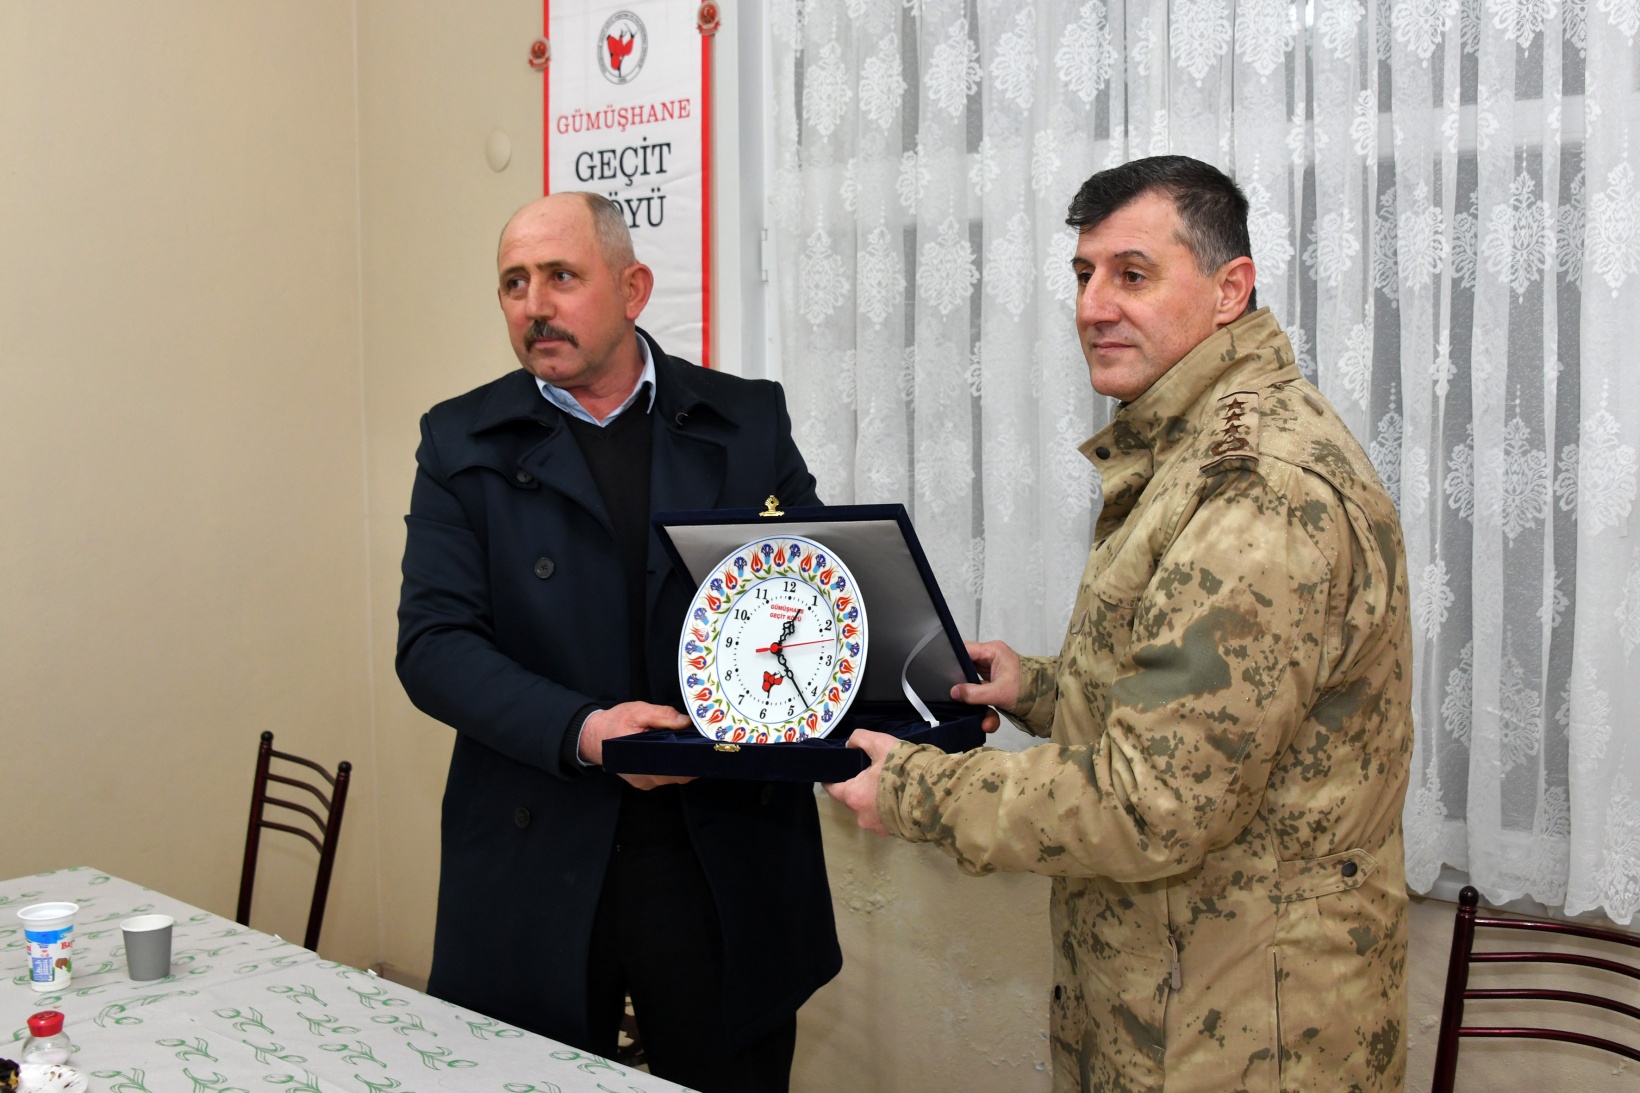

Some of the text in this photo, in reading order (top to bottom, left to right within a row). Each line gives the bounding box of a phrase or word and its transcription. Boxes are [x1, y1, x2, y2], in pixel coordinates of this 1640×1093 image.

[556, 98, 691, 135] GÜMÜŞHANE
[575, 136, 671, 187] GEÇİT
[783, 581, 797, 593] 12
[755, 588, 768, 600] 11
[811, 595, 818, 606] 1
[734, 609, 748, 620] 10
[824, 619, 832, 631] 2
[726, 636, 733, 648] 9
[825, 655, 833, 666] 3
[724, 670, 732, 681] 8
[811, 686, 818, 697] 4
[738, 694, 745, 705] 7
[759, 708, 767, 719] 6
[787, 704, 795, 716] 5
